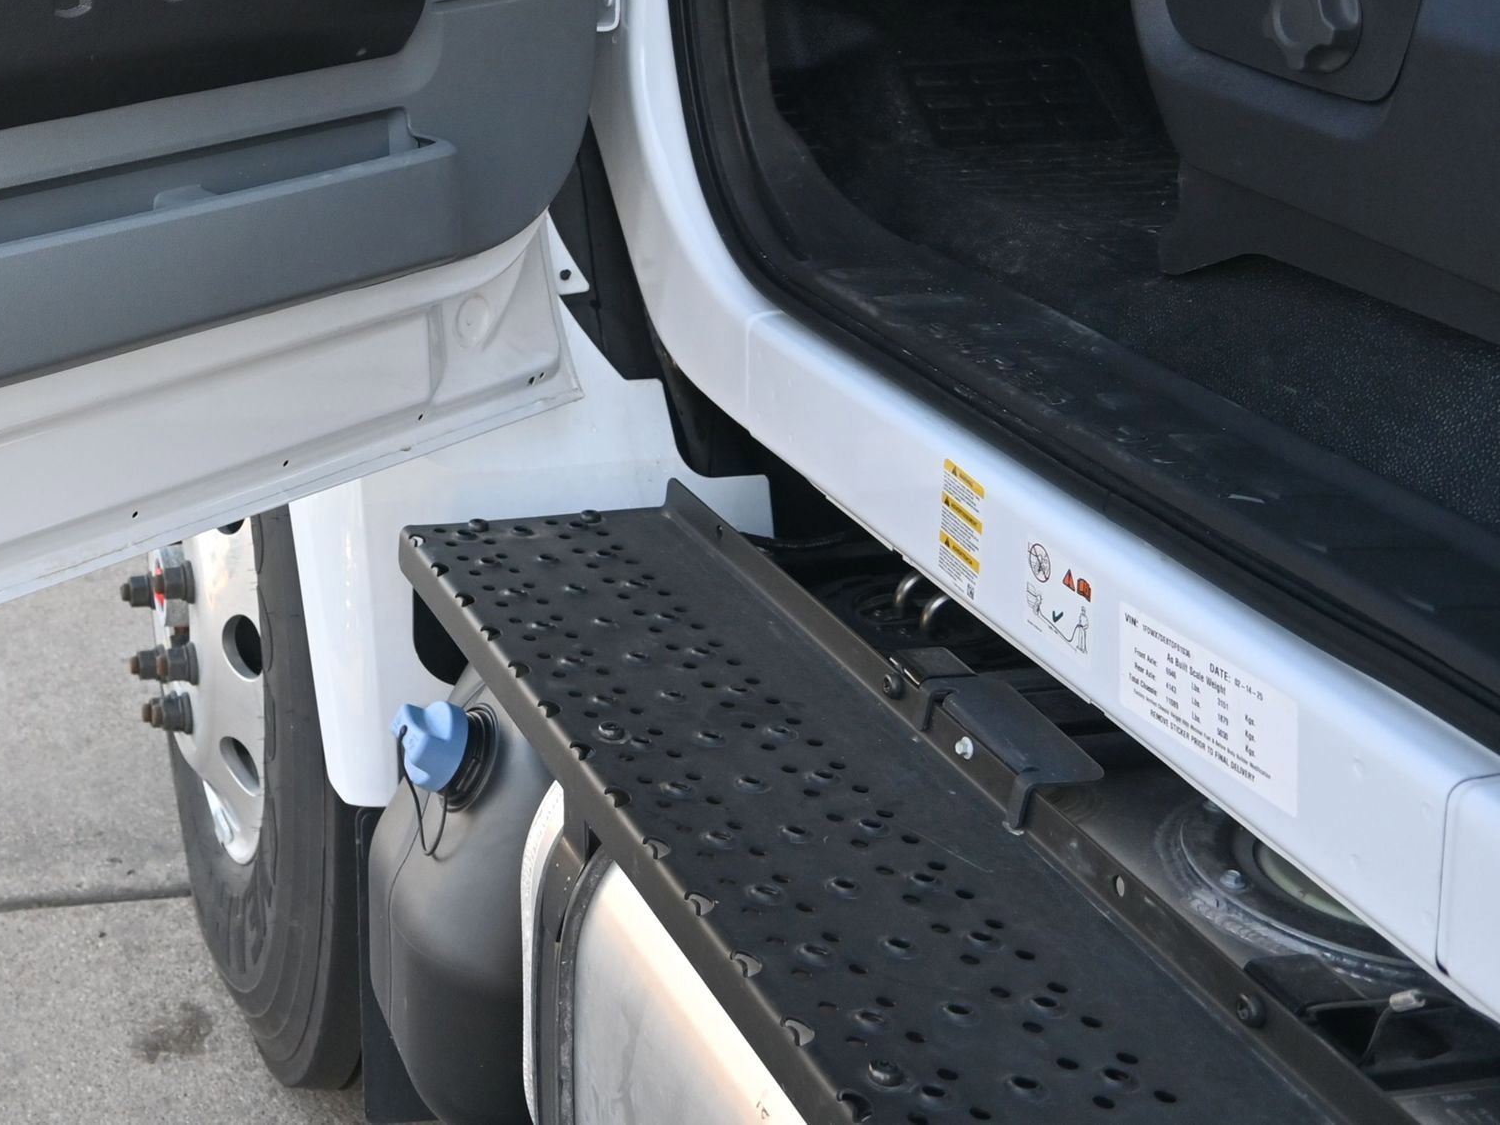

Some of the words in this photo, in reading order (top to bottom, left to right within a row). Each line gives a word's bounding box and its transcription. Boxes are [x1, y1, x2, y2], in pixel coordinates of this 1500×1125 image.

[1125, 613, 1138, 628] VIN:
[1167, 653, 1173, 664] As
[1175, 657, 1187, 673] Built
[1190, 666, 1204, 683] Scale
[1206, 676, 1226, 698] Weight
[1210, 663, 1231, 684] DATE:
[1151, 709, 1168, 727] REMOVE
[1171, 722, 1189, 741] STICKER
[1191, 735, 1205, 751] PRIOR
[1208, 745, 1213, 756] TO
[1215, 750, 1229, 766] FINAL
[1231, 761, 1255, 783] DELIVERY
